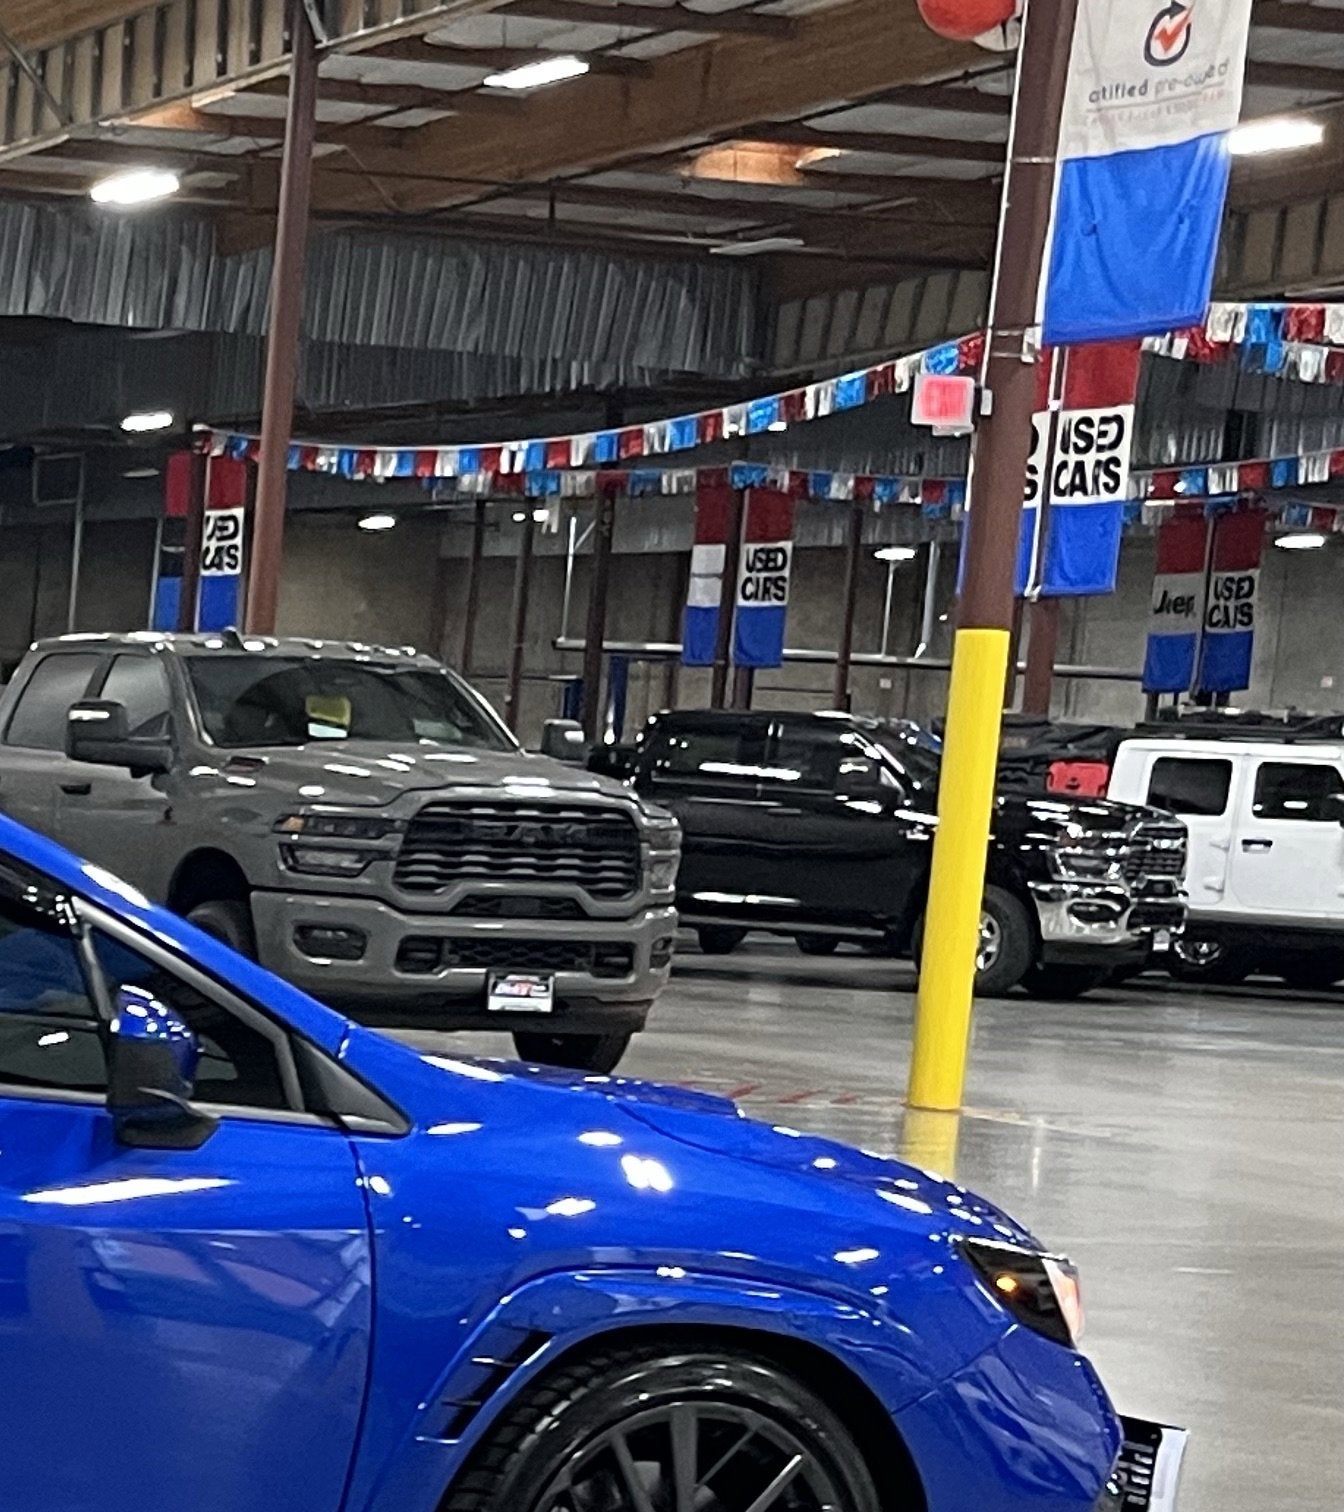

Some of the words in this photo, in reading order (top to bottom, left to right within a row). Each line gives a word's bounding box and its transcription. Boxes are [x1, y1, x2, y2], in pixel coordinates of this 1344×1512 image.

[1060, 414, 1124, 454] USED
[1053, 456, 1121, 497] CARS
[746, 547, 787, 573] USED
[1214, 575, 1255, 601] USED
